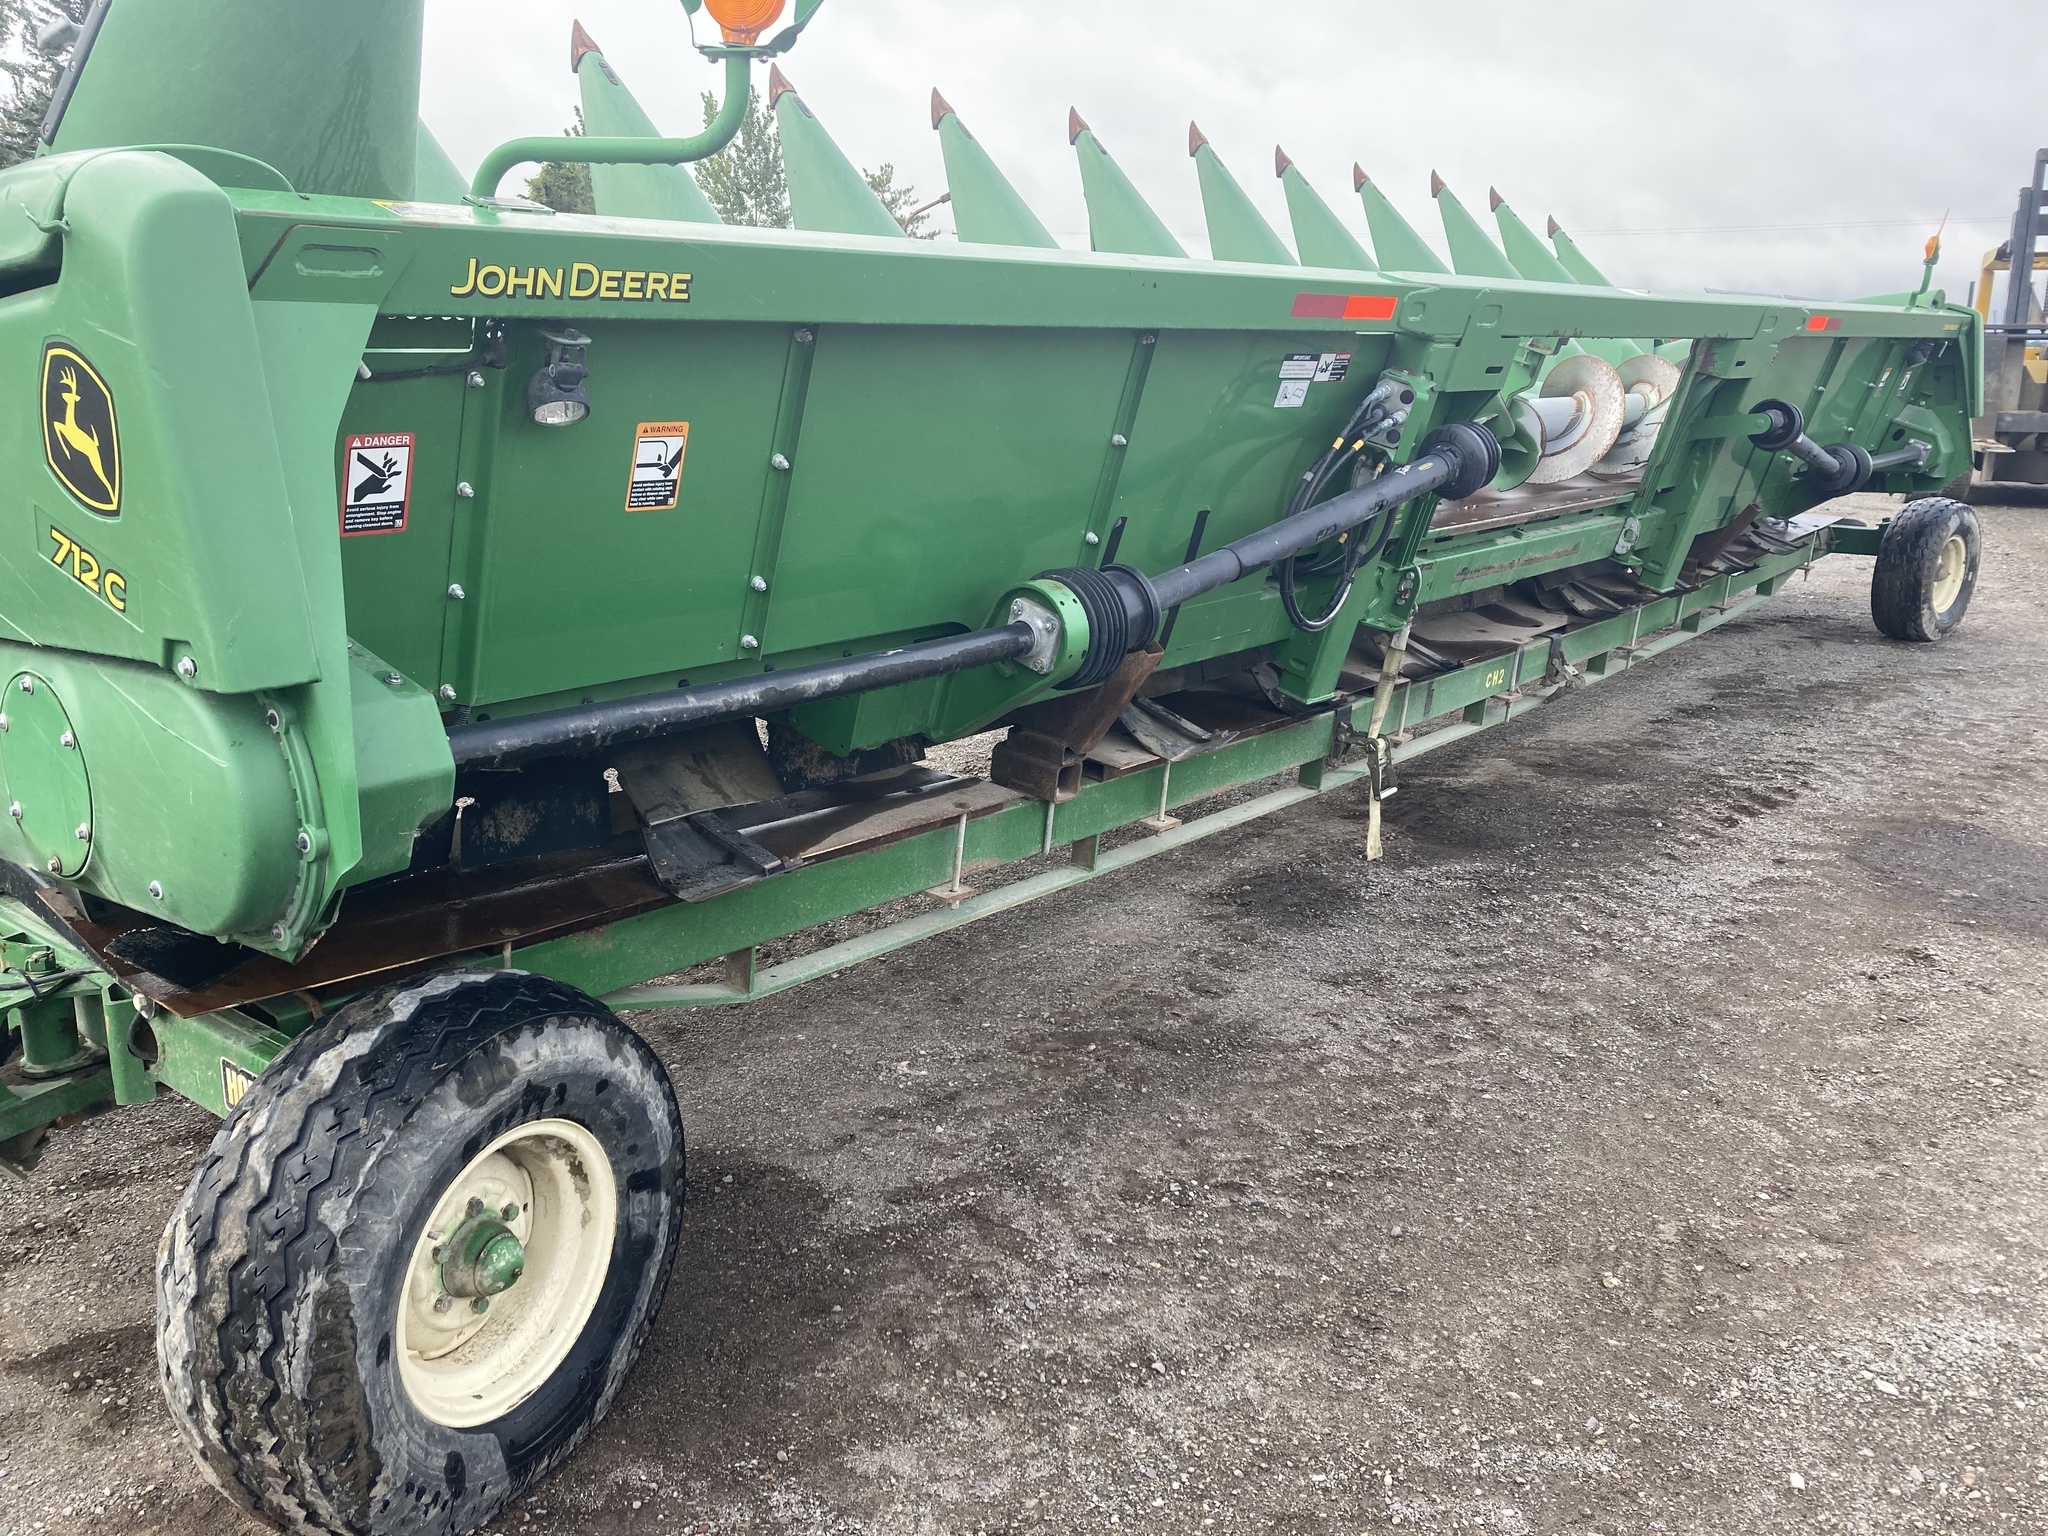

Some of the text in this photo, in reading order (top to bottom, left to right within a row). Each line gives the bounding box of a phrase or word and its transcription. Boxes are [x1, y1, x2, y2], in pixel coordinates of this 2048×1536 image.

[451, 258, 693, 301] JOHN DEERE
[364, 435, 410, 446] DANGER
[1485, 668, 1505, 688] CH2
[225, 1067, 254, 1106] HO
